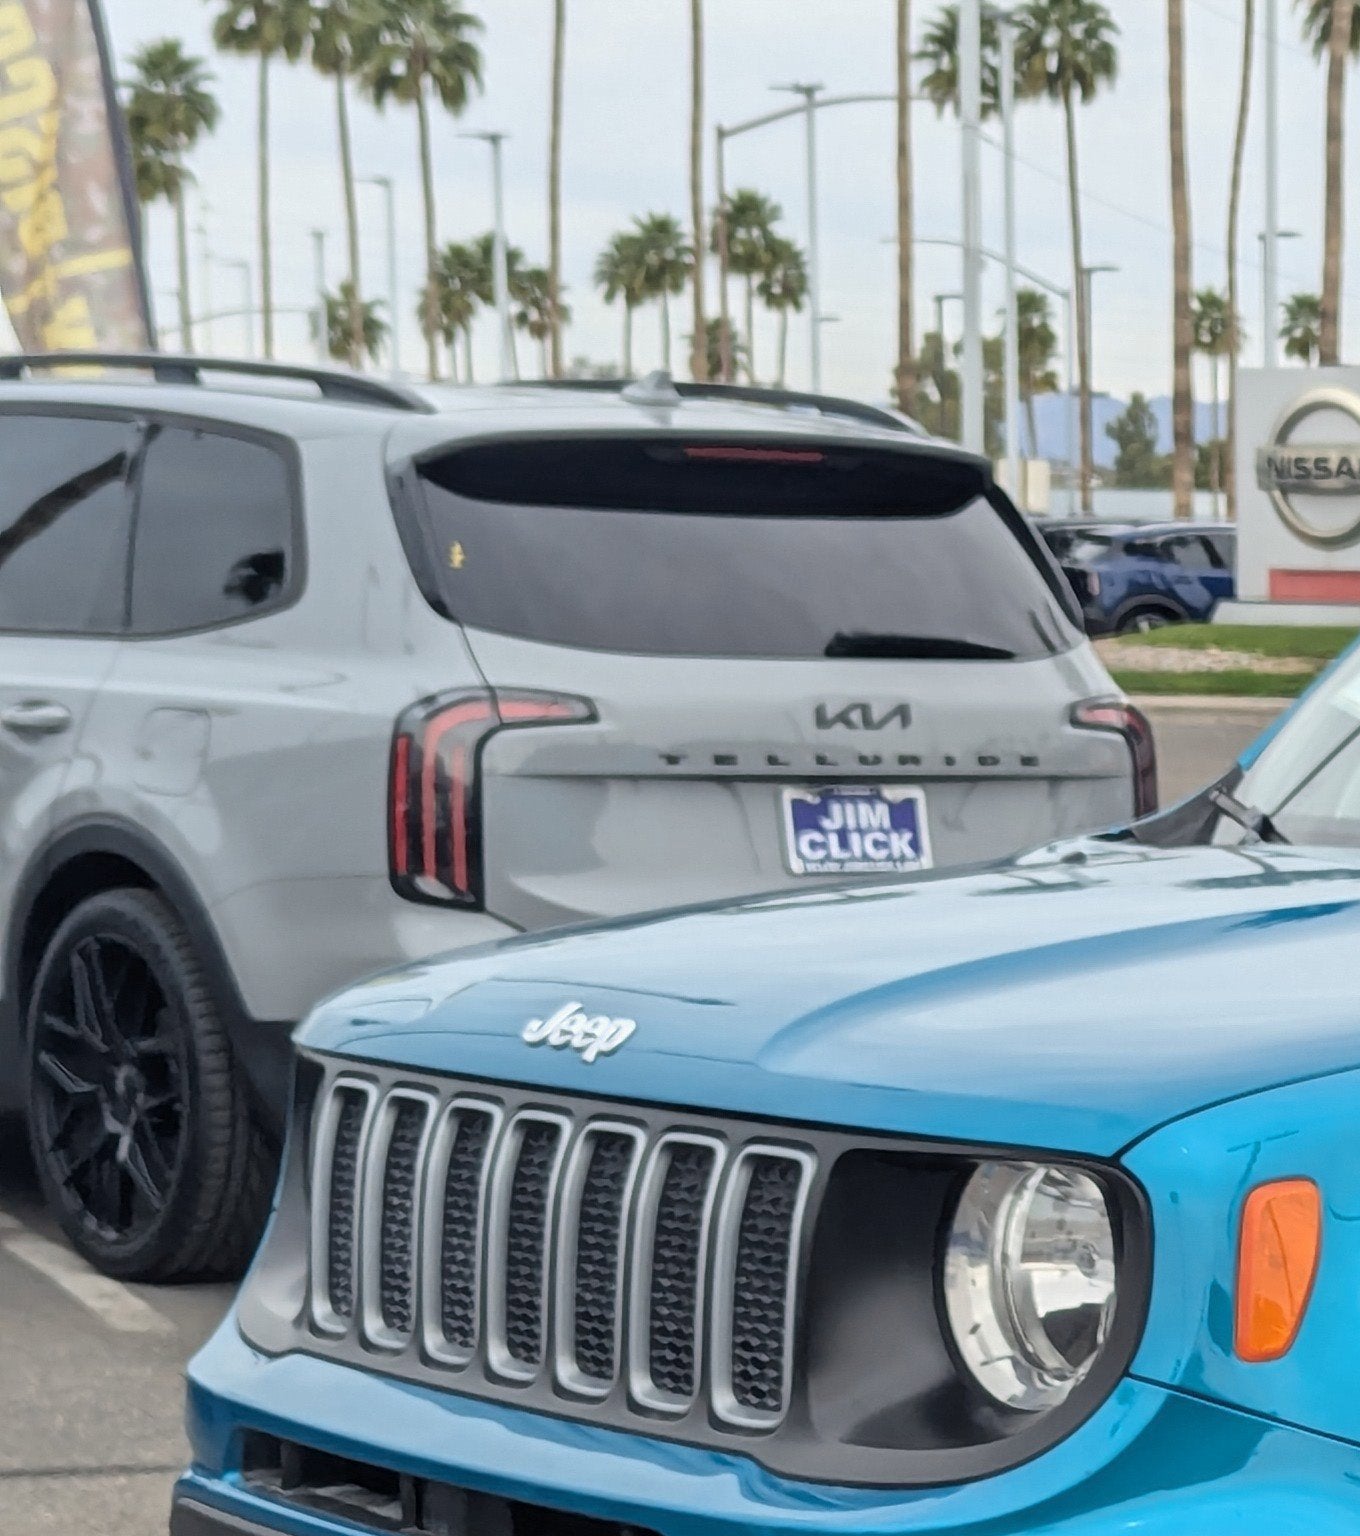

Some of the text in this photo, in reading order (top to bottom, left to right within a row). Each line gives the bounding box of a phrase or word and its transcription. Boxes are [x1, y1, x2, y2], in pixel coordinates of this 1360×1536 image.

[815, 703, 912, 730] KIA
[659, 754, 1039, 766] TELLURIDE
[818, 800, 891, 830] JIM
[800, 830, 916, 860] CLICK
[522, 1001, 636, 1063] Jeep
